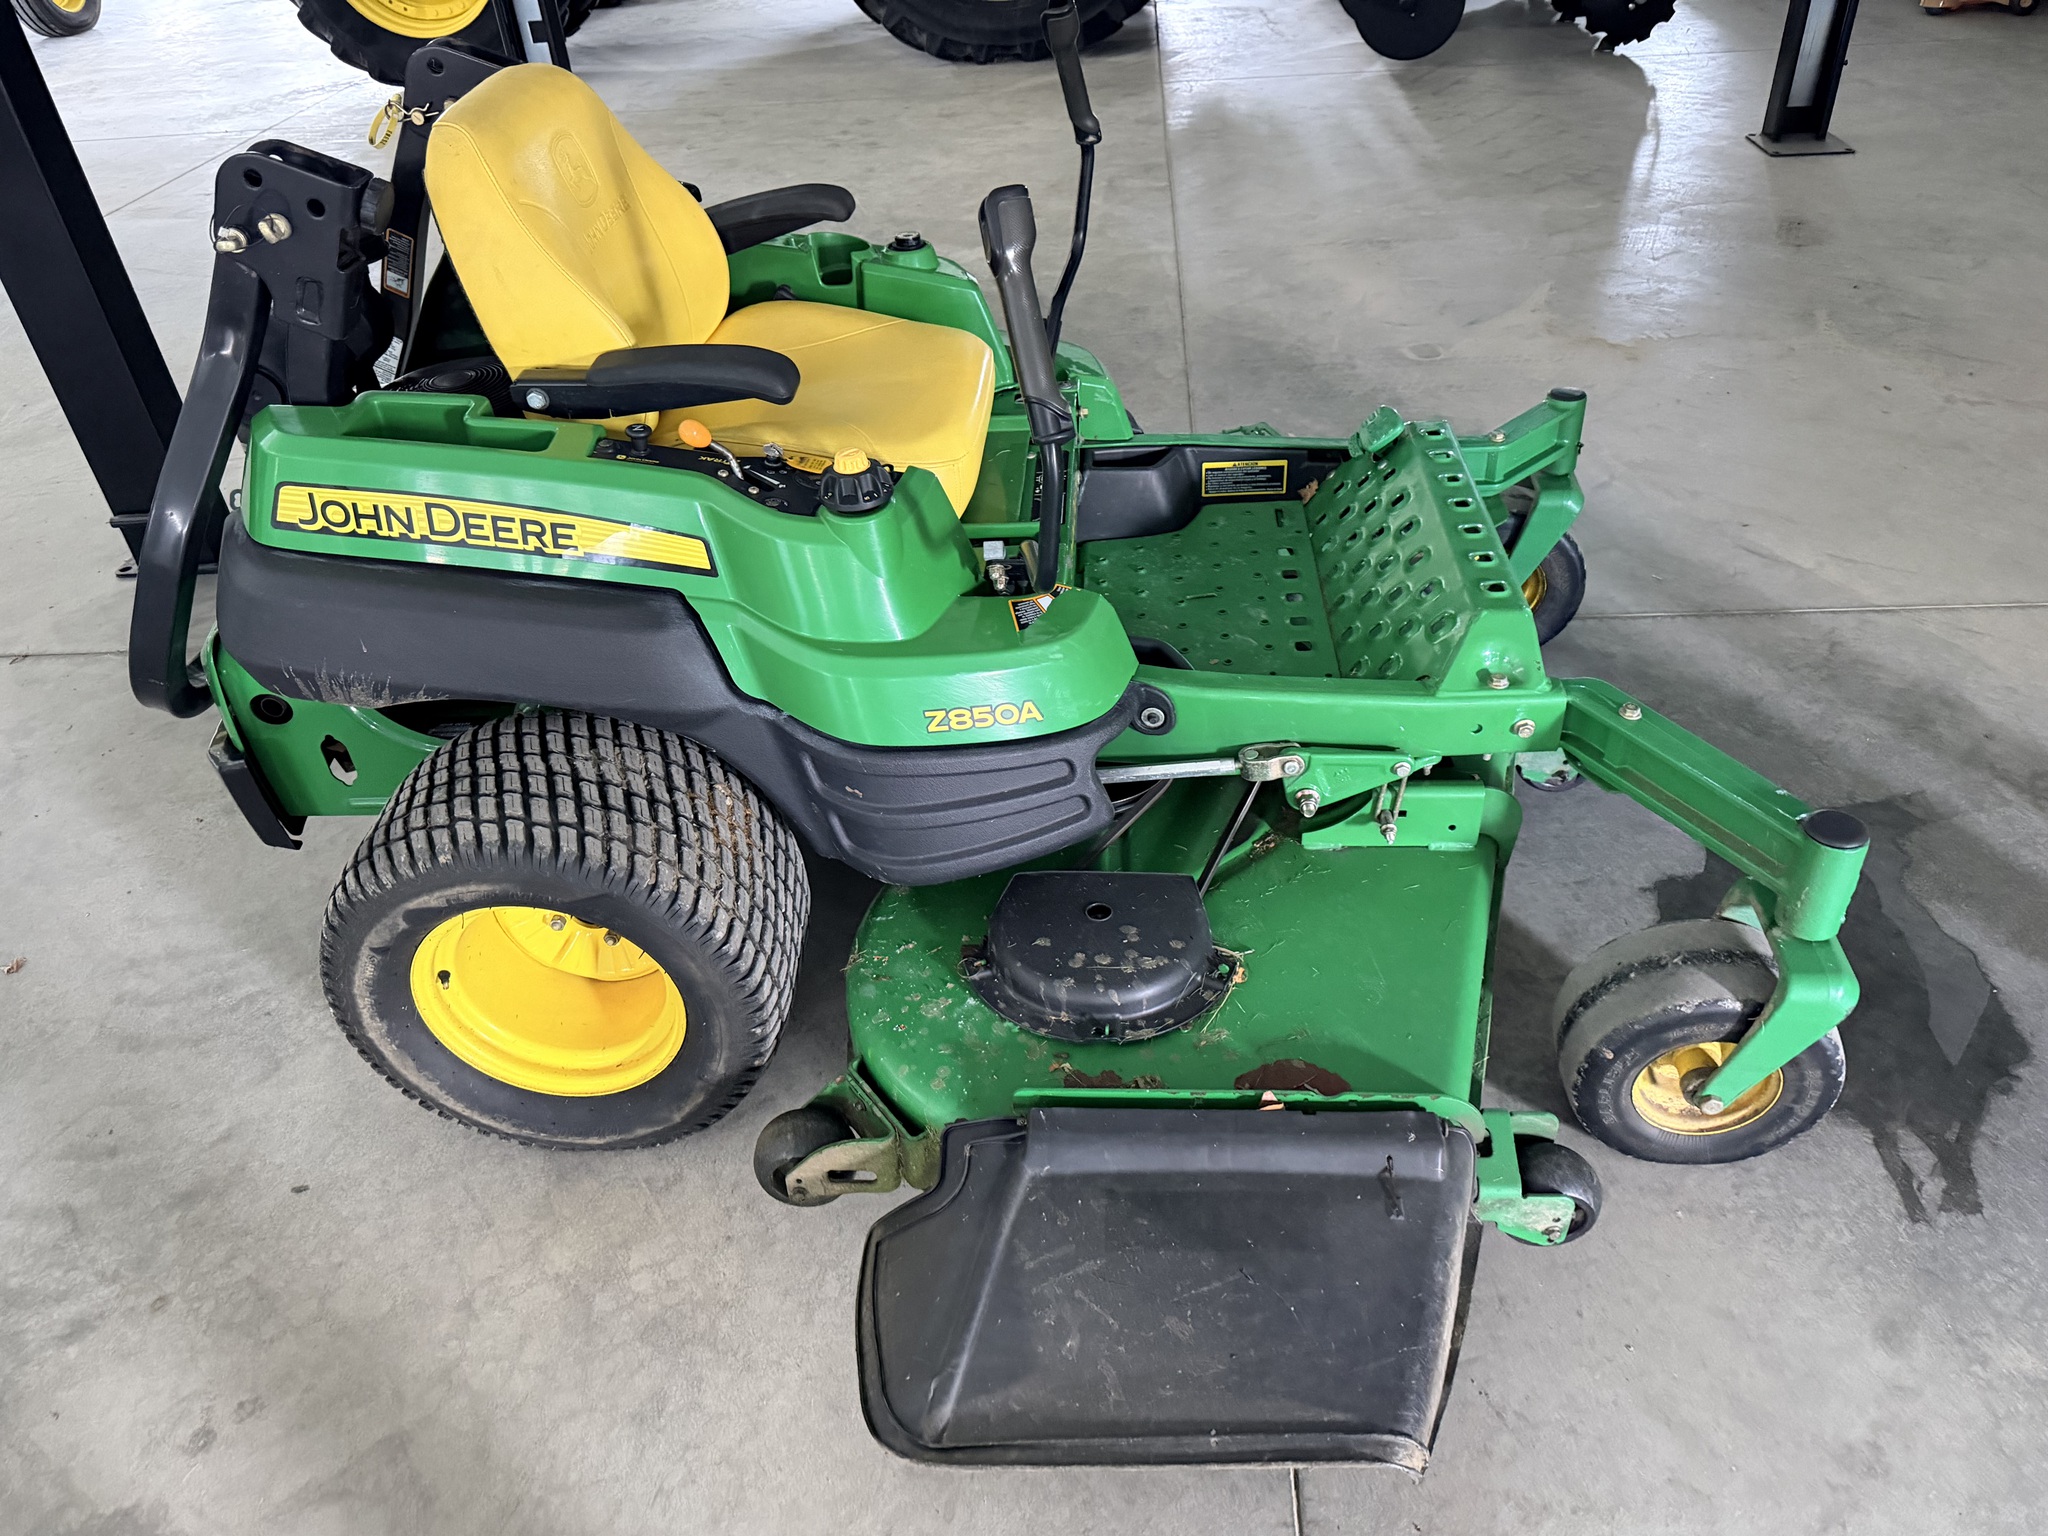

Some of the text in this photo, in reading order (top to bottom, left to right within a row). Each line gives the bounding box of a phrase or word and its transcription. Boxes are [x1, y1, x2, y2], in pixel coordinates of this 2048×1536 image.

[299, 492, 577, 549] JOHN DEERE
[923, 700, 1044, 733] Z850A
